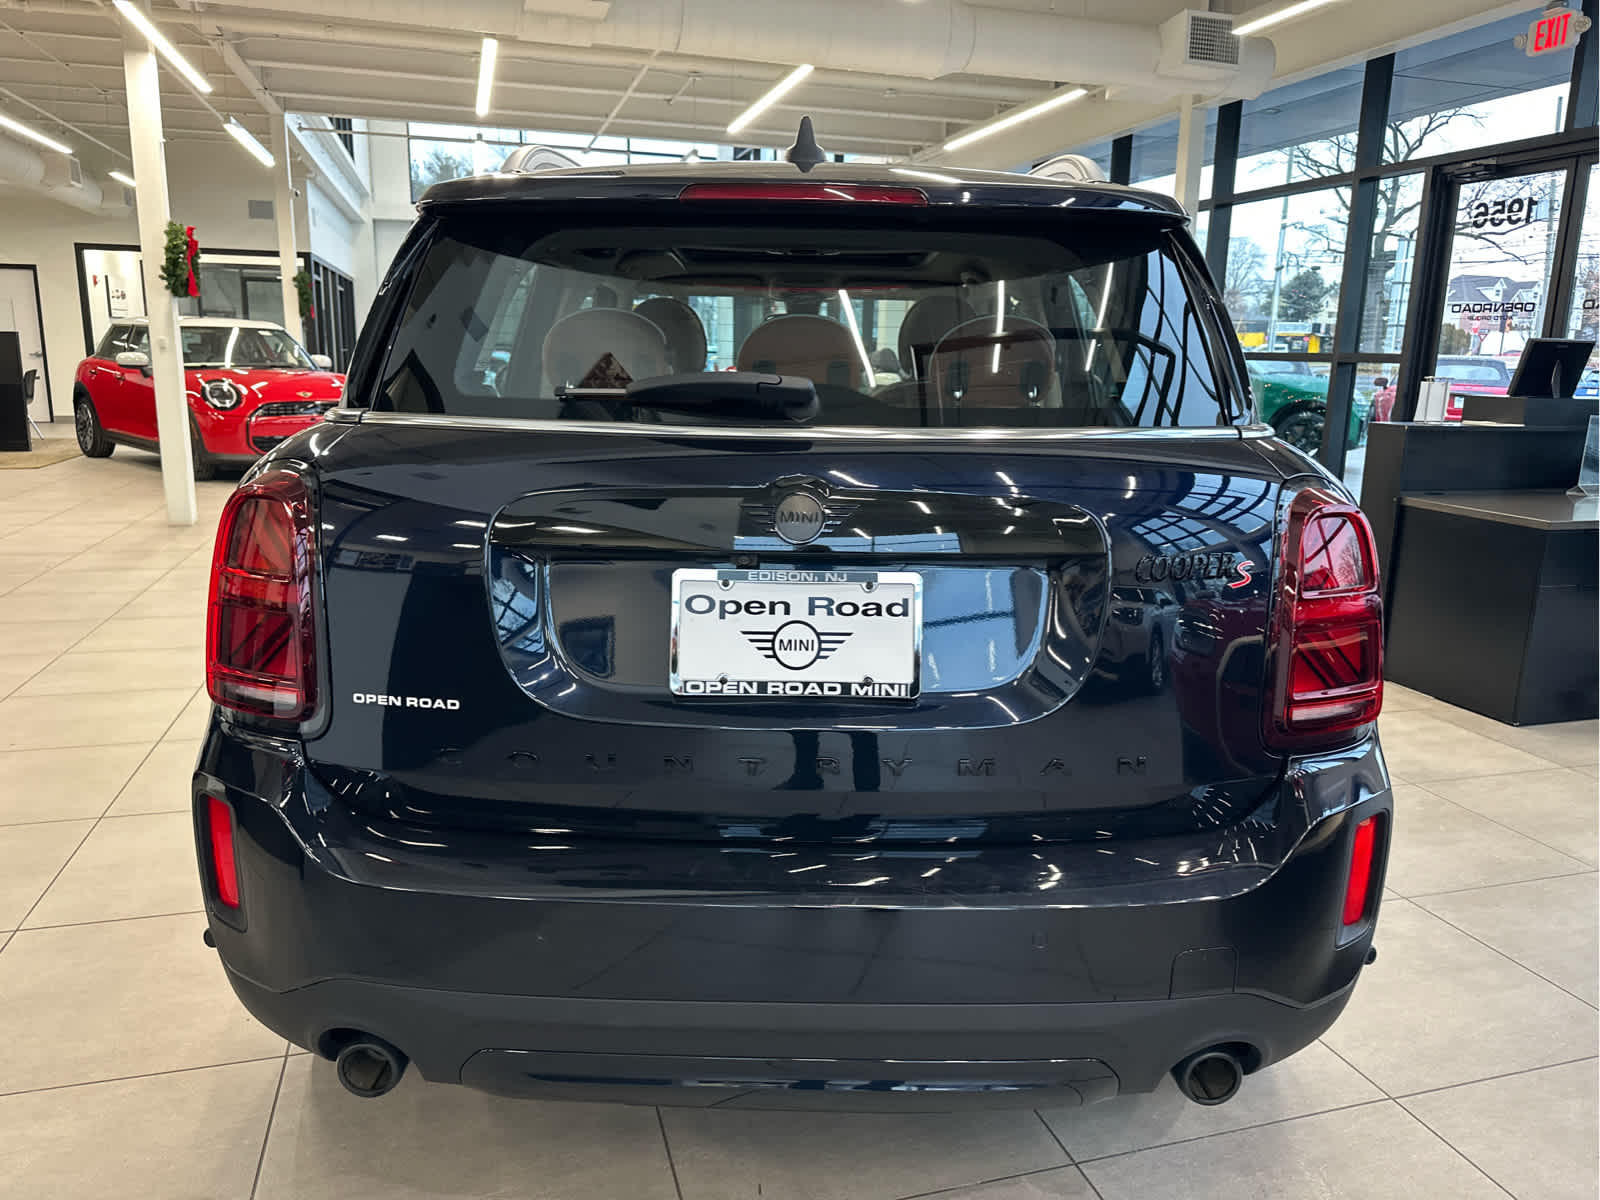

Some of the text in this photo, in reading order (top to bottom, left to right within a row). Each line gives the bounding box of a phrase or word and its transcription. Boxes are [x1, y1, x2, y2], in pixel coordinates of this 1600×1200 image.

[1533, 11, 1572, 52] EXIT
[780, 511, 819, 523] MINI
[747, 570, 848, 583] EDISON, NJ
[1136, 551, 1255, 589] COOPER S
[685, 594, 909, 620] Open Road
[779, 638, 815, 652] MINI
[686, 680, 907, 697] OPEN ROAD MINI
[352, 692, 460, 710] OPEN ROAD
[437, 743, 1147, 776] COUNTRYMAN
